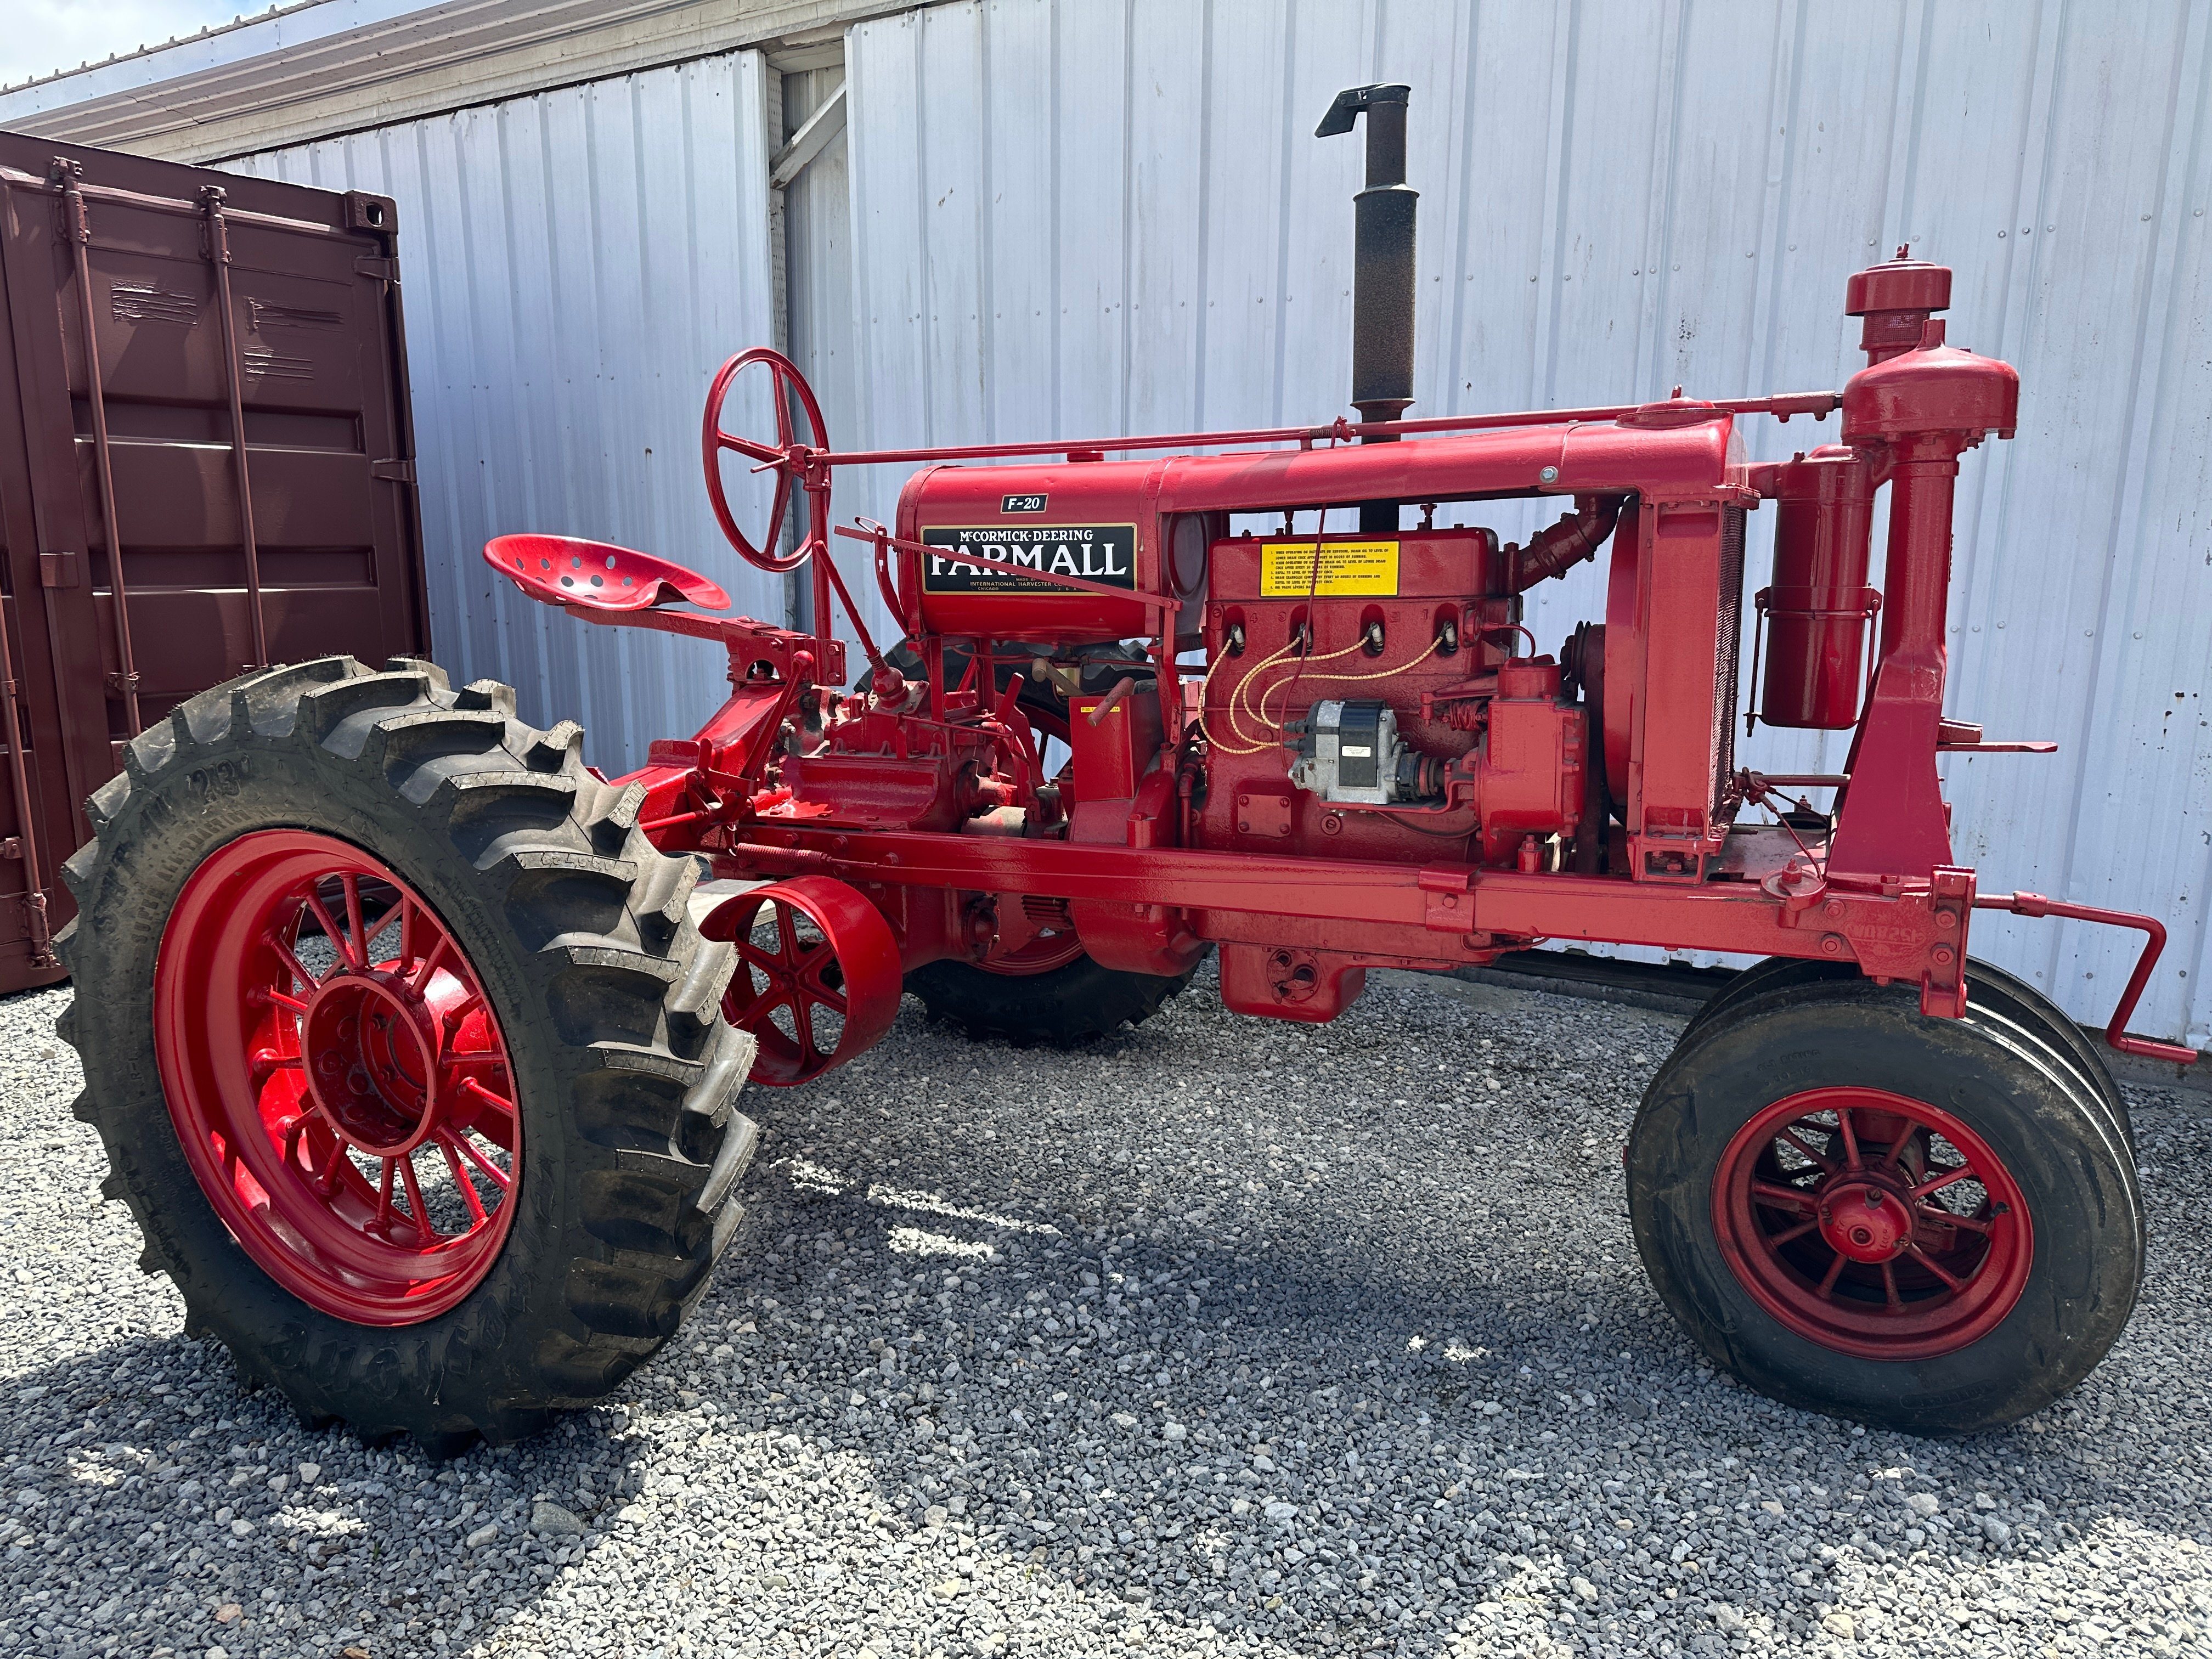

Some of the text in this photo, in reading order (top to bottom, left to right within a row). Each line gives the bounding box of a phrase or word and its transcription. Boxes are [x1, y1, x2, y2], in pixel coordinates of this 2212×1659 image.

[1007, 497, 1040, 510] F-20
[960, 529, 1093, 543] McCORMICK-DEERING
[930, 543, 1127, 576] FARMALL
[1250, 612, 1258, 624] 4
[1278, 611, 1286, 623] 3
[1422, 608, 1429, 620] 1
[132, 884, 164, 945] SUPER
